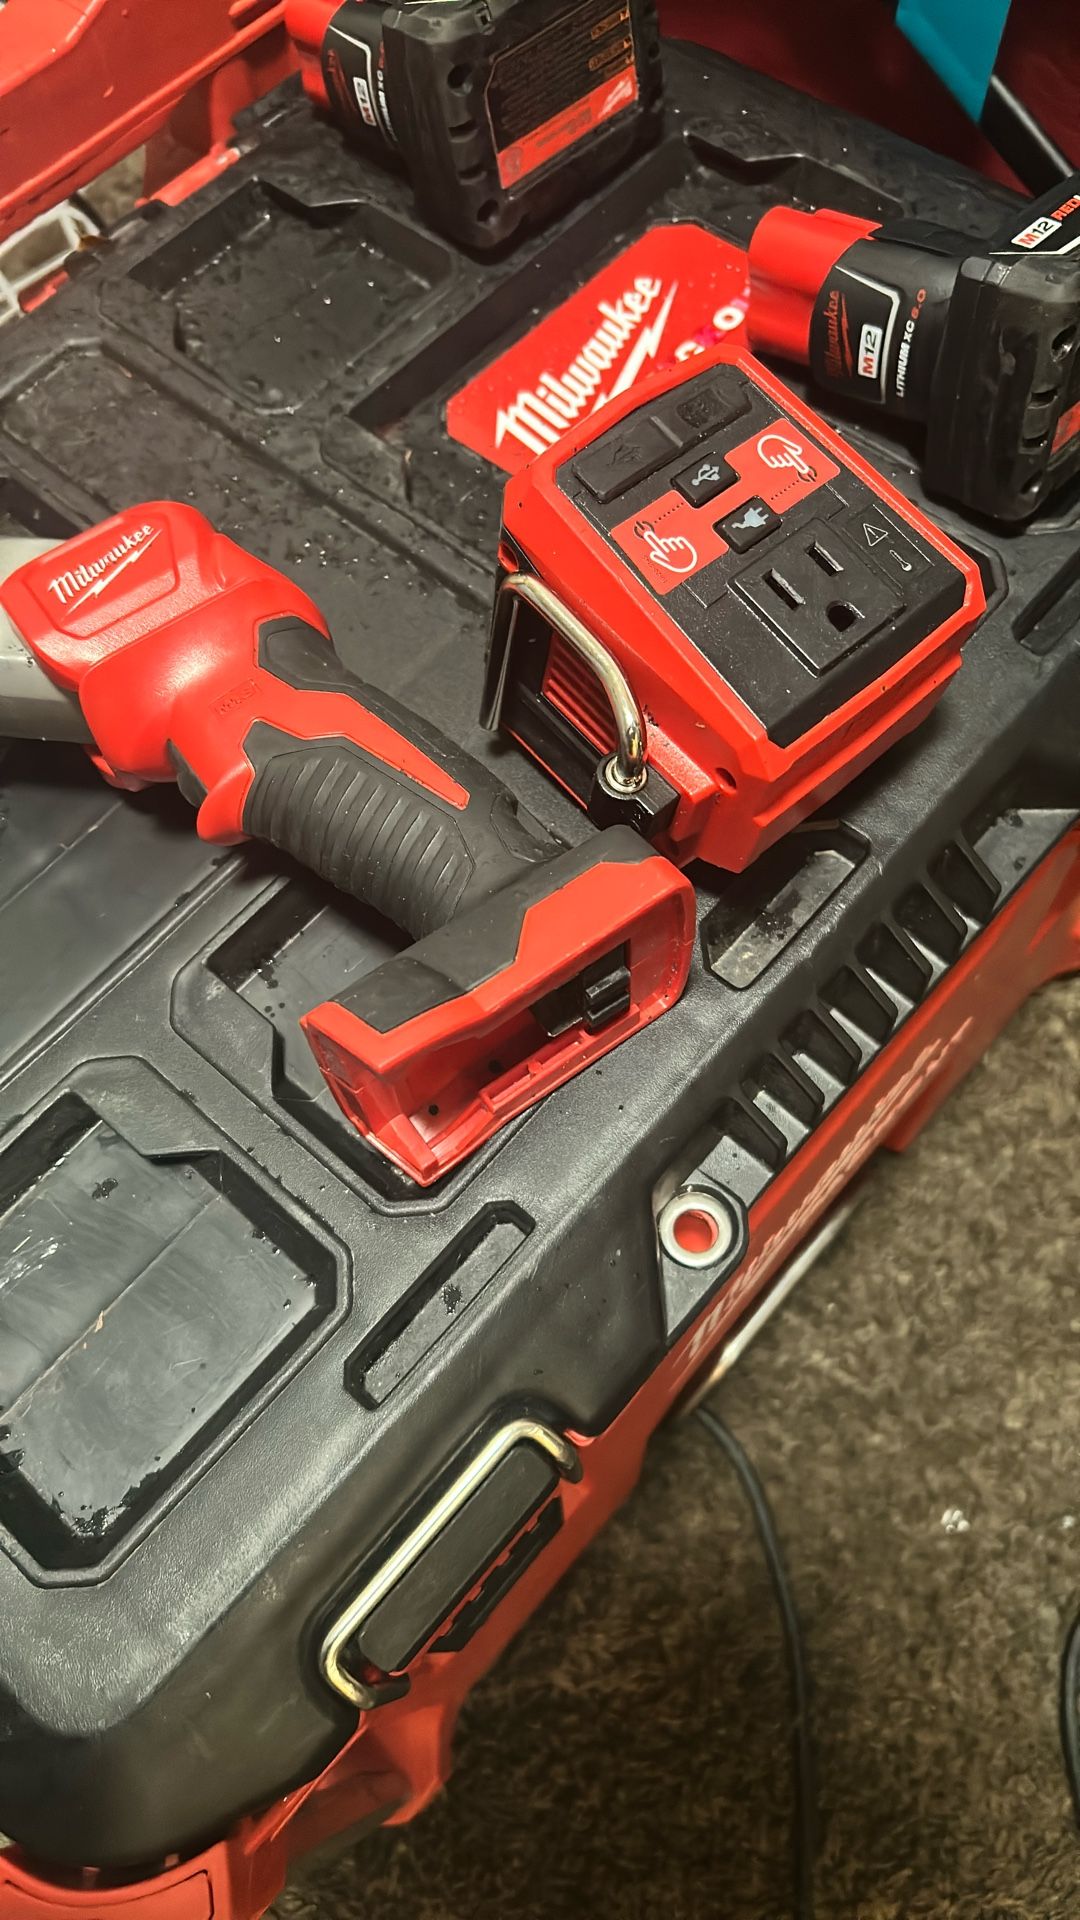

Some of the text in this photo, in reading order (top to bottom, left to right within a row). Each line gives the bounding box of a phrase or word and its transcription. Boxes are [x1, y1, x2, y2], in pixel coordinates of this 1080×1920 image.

[1018, 220, 1055, 246] M12
[862, 329, 878, 376] M12
[903, 319, 915, 343] XC
[494, 276, 662, 456] Milwaukee
[896, 341, 911, 398] LITHIUM
[47, 524, 154, 604] Milwaukee
